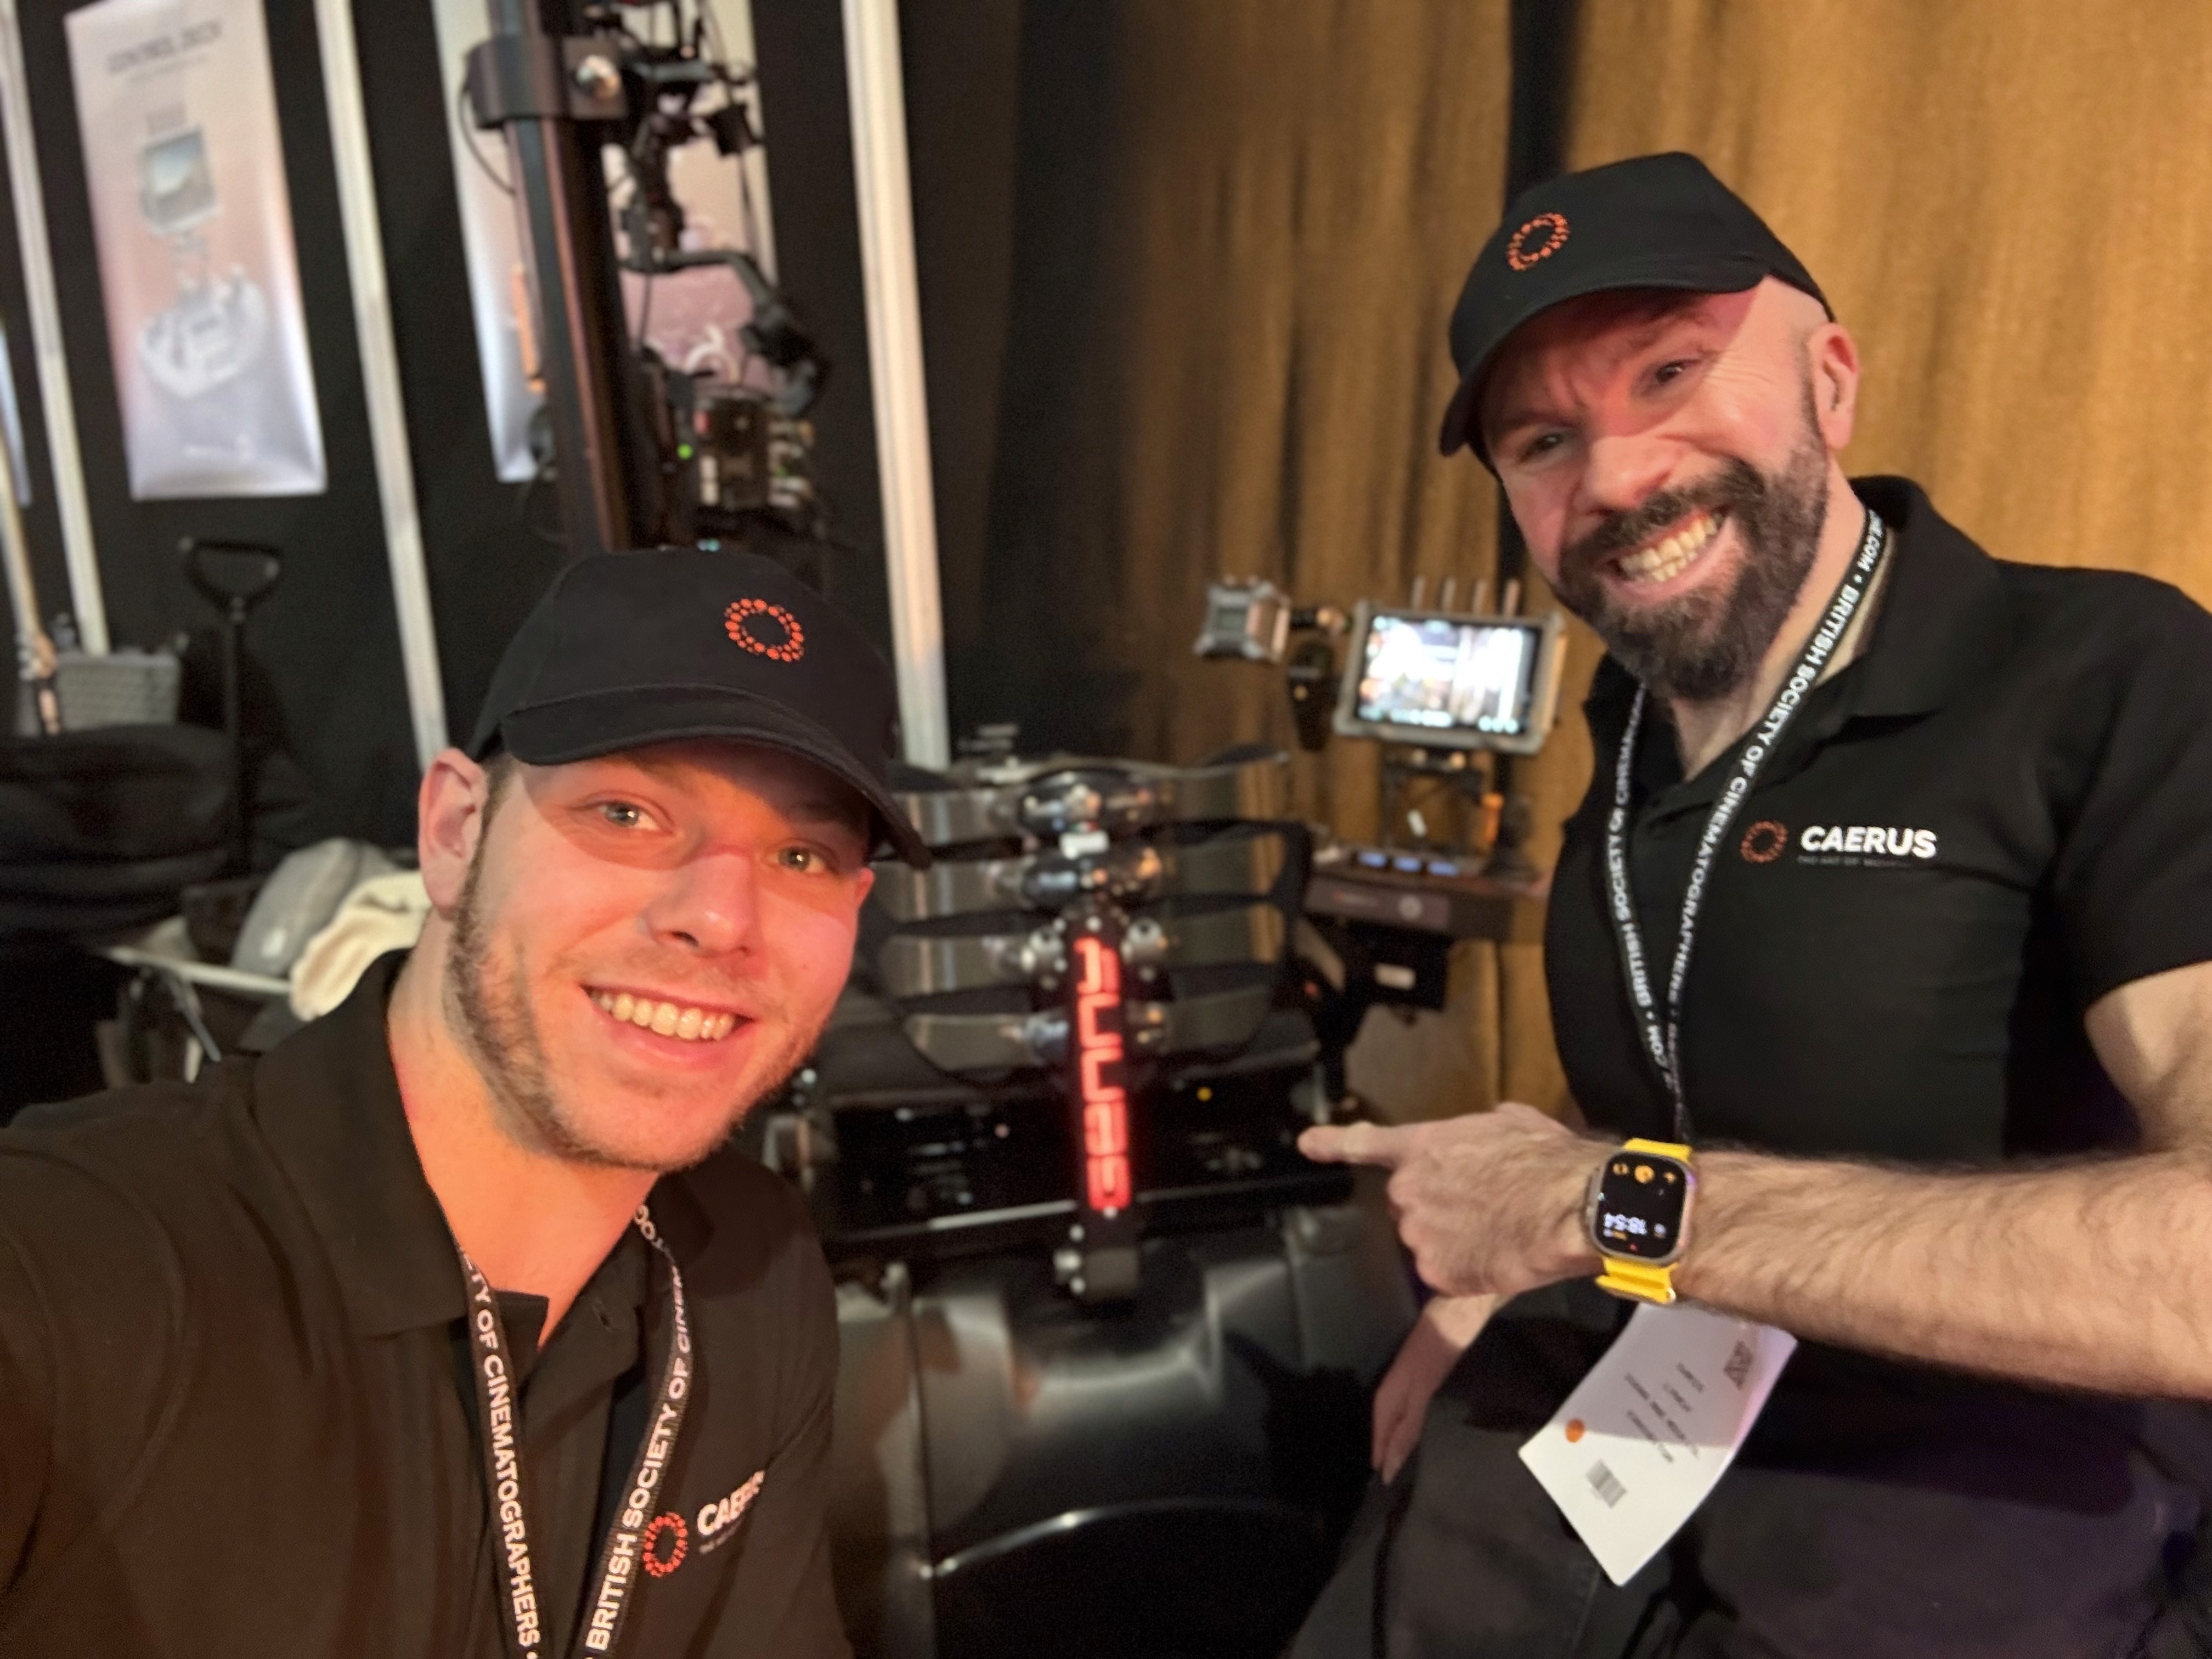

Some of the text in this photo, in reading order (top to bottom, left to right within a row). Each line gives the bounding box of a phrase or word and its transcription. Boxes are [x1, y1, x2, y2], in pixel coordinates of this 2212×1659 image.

[1805, 584, 1860, 665] BRITISH
[1757, 664, 1816, 746] SOCIETY
[1741, 745, 1764, 778] OF
[1800, 825, 1938, 859] CAERUS
[476, 1308, 499, 1350] OF
[483, 1354, 541, 1647] CINEMATOGRAPHERS
[585, 1533, 638, 1651] BRITISH
[622, 1402, 677, 1528] SOCIETY
[668, 1357, 689, 1400] OF
